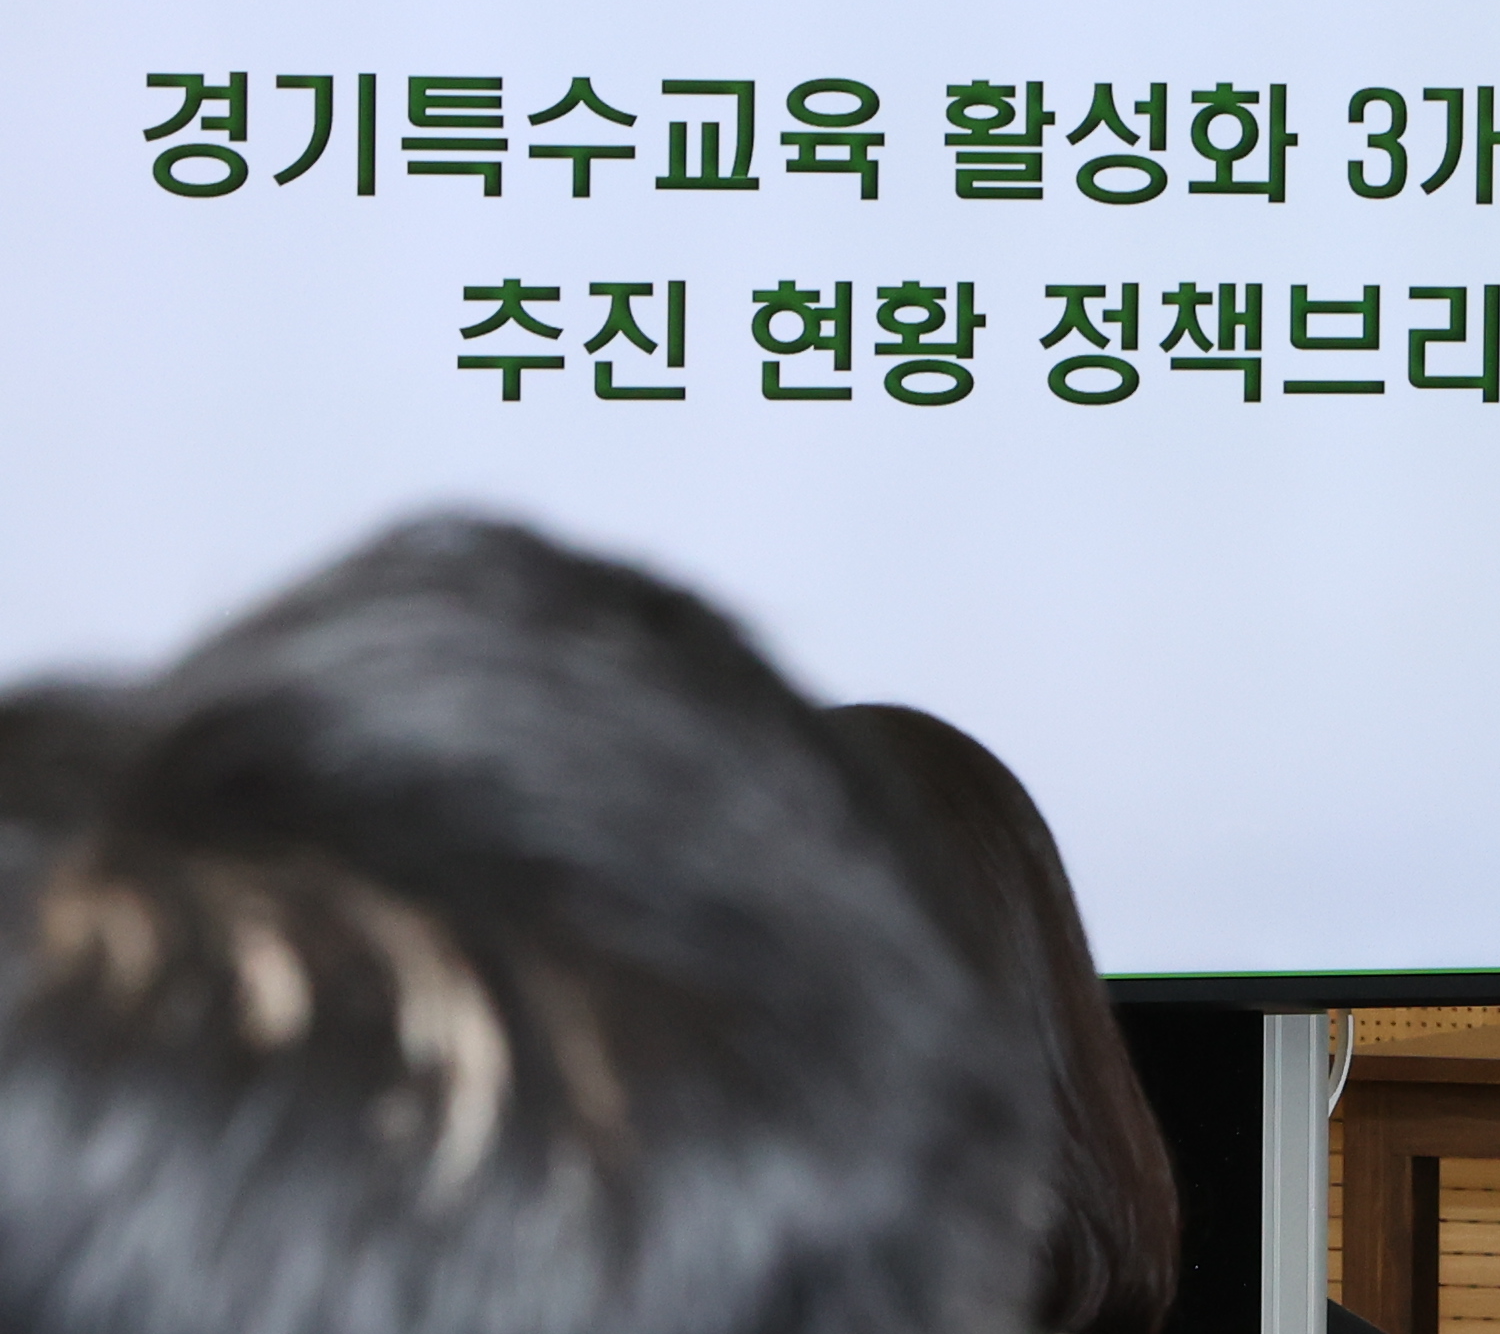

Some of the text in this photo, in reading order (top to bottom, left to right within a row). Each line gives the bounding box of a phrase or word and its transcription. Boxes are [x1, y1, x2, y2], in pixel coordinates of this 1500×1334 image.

[141, 71, 887, 202] 경기특수교육
[942, 78, 1300, 207] 활성화
[455, 278, 688, 403] 추진
[750, 279, 988, 408] 현황
